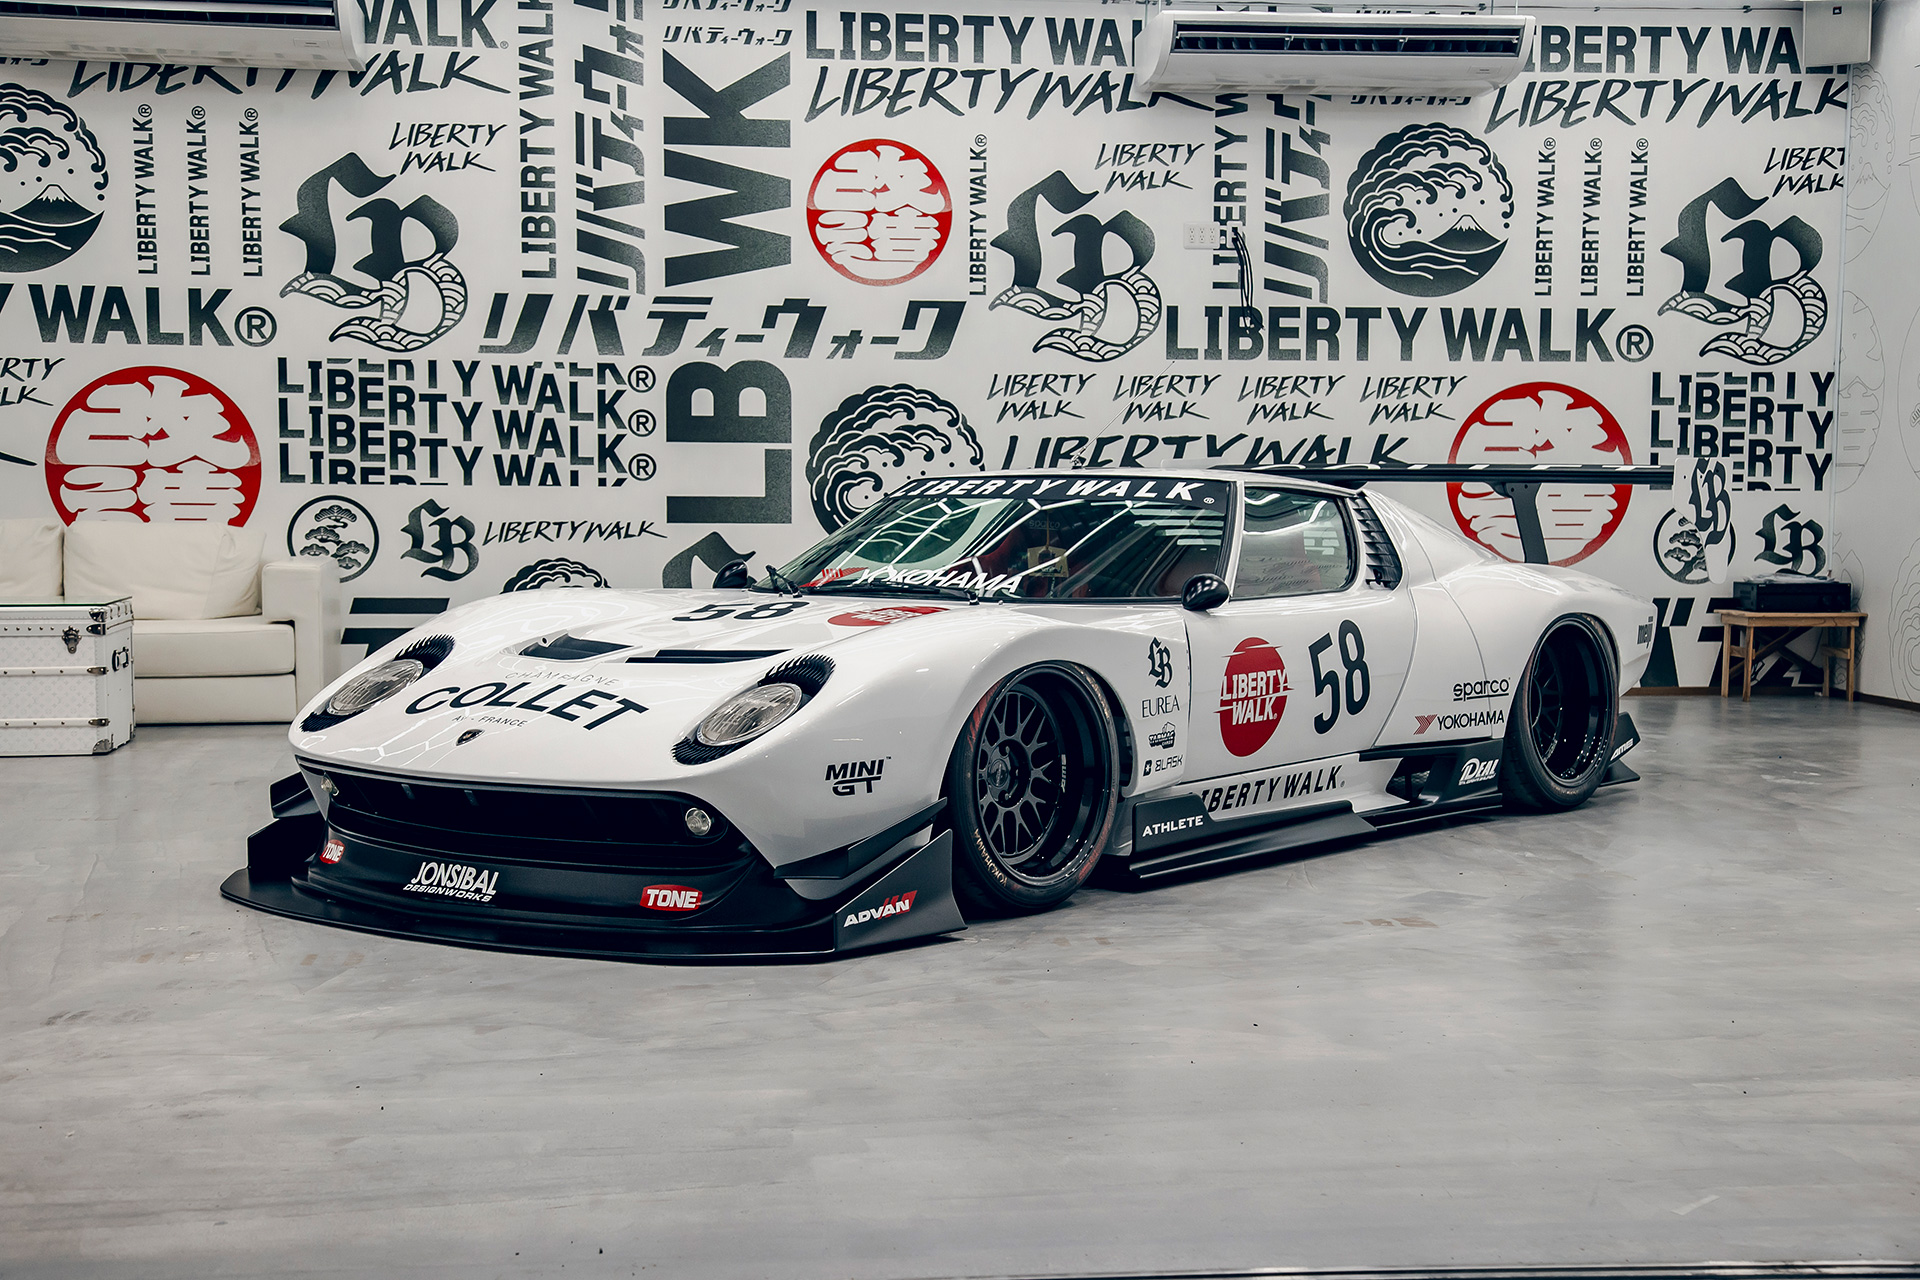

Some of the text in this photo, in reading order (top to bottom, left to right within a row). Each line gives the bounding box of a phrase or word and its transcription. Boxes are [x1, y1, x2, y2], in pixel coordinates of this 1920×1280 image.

[662, 25, 793, 46] リバティーウォーク
[806, 11, 1144, 67] LIBERTY WA
[1721, 26, 1848, 75] WA
[804, 66, 1040, 122] LIBERTY
[1485, 77, 1848, 134] LIBERTY WALK
[388, 122, 508, 151] LIBERTY
[573, 0, 646, 295] リバティーウォー
[399, 150, 497, 176] WALK
[1096, 143, 1207, 172] LIBERTY
[519, 107, 557, 279] LIBERTY
[1104, 169, 1194, 193] WALK
[136, 183, 158, 275] LIBERTY
[189, 185, 211, 276] LIBERTY
[241, 187, 263, 277] LIBERTY
[969, 209, 988, 296] LIBERTY
[1534, 211, 1554, 296] LIBERTY
[1580, 211, 1600, 297] LIBERTY
[1626, 211, 1646, 297] LIBERTY
[477, 291, 967, 361] リバティーウォーク
[1165, 305, 1428, 362] LIBERTY
[0, 357, 65, 382] RTY
[987, 373, 1097, 400] LIBERTY
[1113, 374, 1222, 401] LIBERTY
[1237, 374, 1346, 402] LIBERTY
[1360, 375, 1468, 402] LIBERTY
[996, 399, 1085, 424] WALK
[1122, 400, 1210, 425] WALK
[1247, 402, 1335, 425] WALK
[1370, 402, 1456, 426] WALK
[889, 479, 1066, 498] LIBERTY
[482, 521, 588, 546] LIBERTY
[582, 521, 668, 544] WALK
[1028, 519, 1061, 529] spaco
[672, 601, 810, 622] 58
[1220, 669, 1290, 701] LIBERTY
[1308, 619, 1371, 735] 58
[1453, 677, 1511, 702] sparco
[405, 681, 650, 731] COLLET
[1142, 694, 1181, 718] EUREA
[478, 716, 529, 728] FRANCE
[1437, 710, 1505, 731] YOKOHAMA
[825, 759, 885, 781] MINI
[832, 776, 882, 797] GT
[1200, 776, 1283, 813] IBERTY
[1142, 815, 1204, 837] ATHLETE
[322, 842, 345, 863] TONE
[410, 861, 500, 896] JONSIBAL
[402, 883, 493, 903] DESIGNWORKS
[647, 888, 699, 909] TONE
[843, 899, 911, 928] ADVAN
